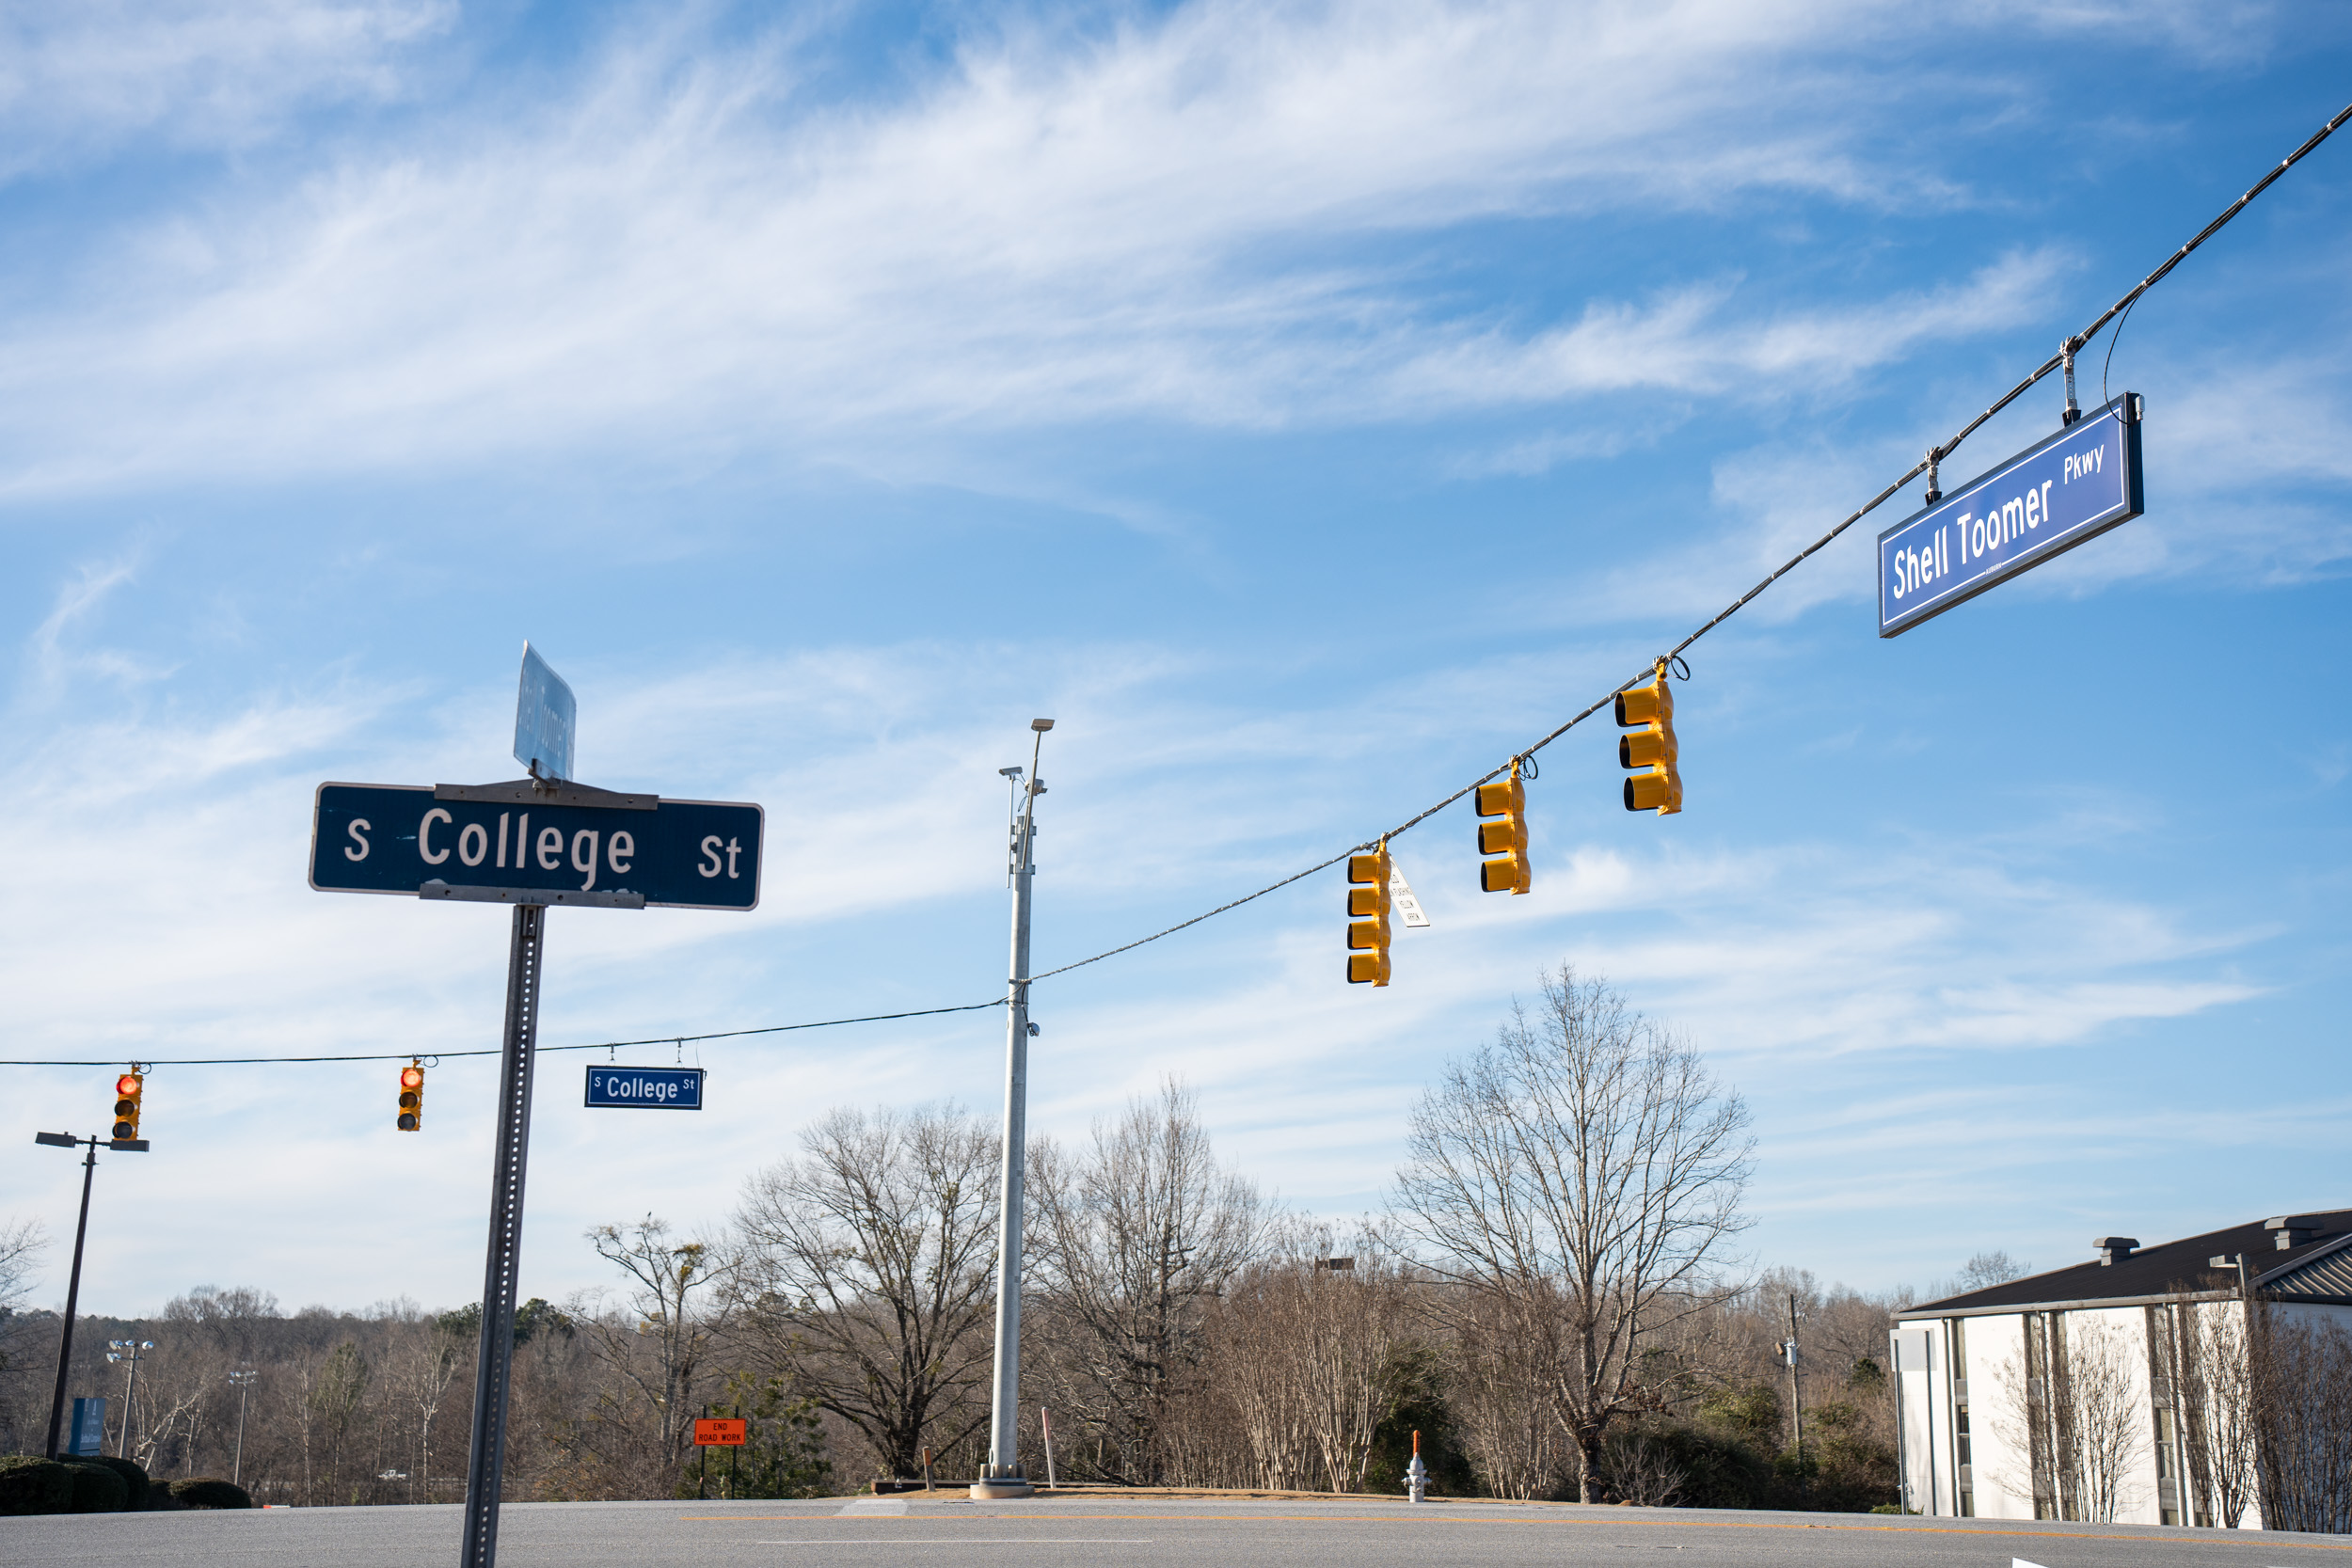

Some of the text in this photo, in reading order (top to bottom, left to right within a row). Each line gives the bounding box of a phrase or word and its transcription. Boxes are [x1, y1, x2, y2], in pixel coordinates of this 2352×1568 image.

[1893, 444, 2105, 598] Shell Toomer Pkwy
[344, 807, 742, 891] S College St
[595, 1077, 694, 1102] S College St
